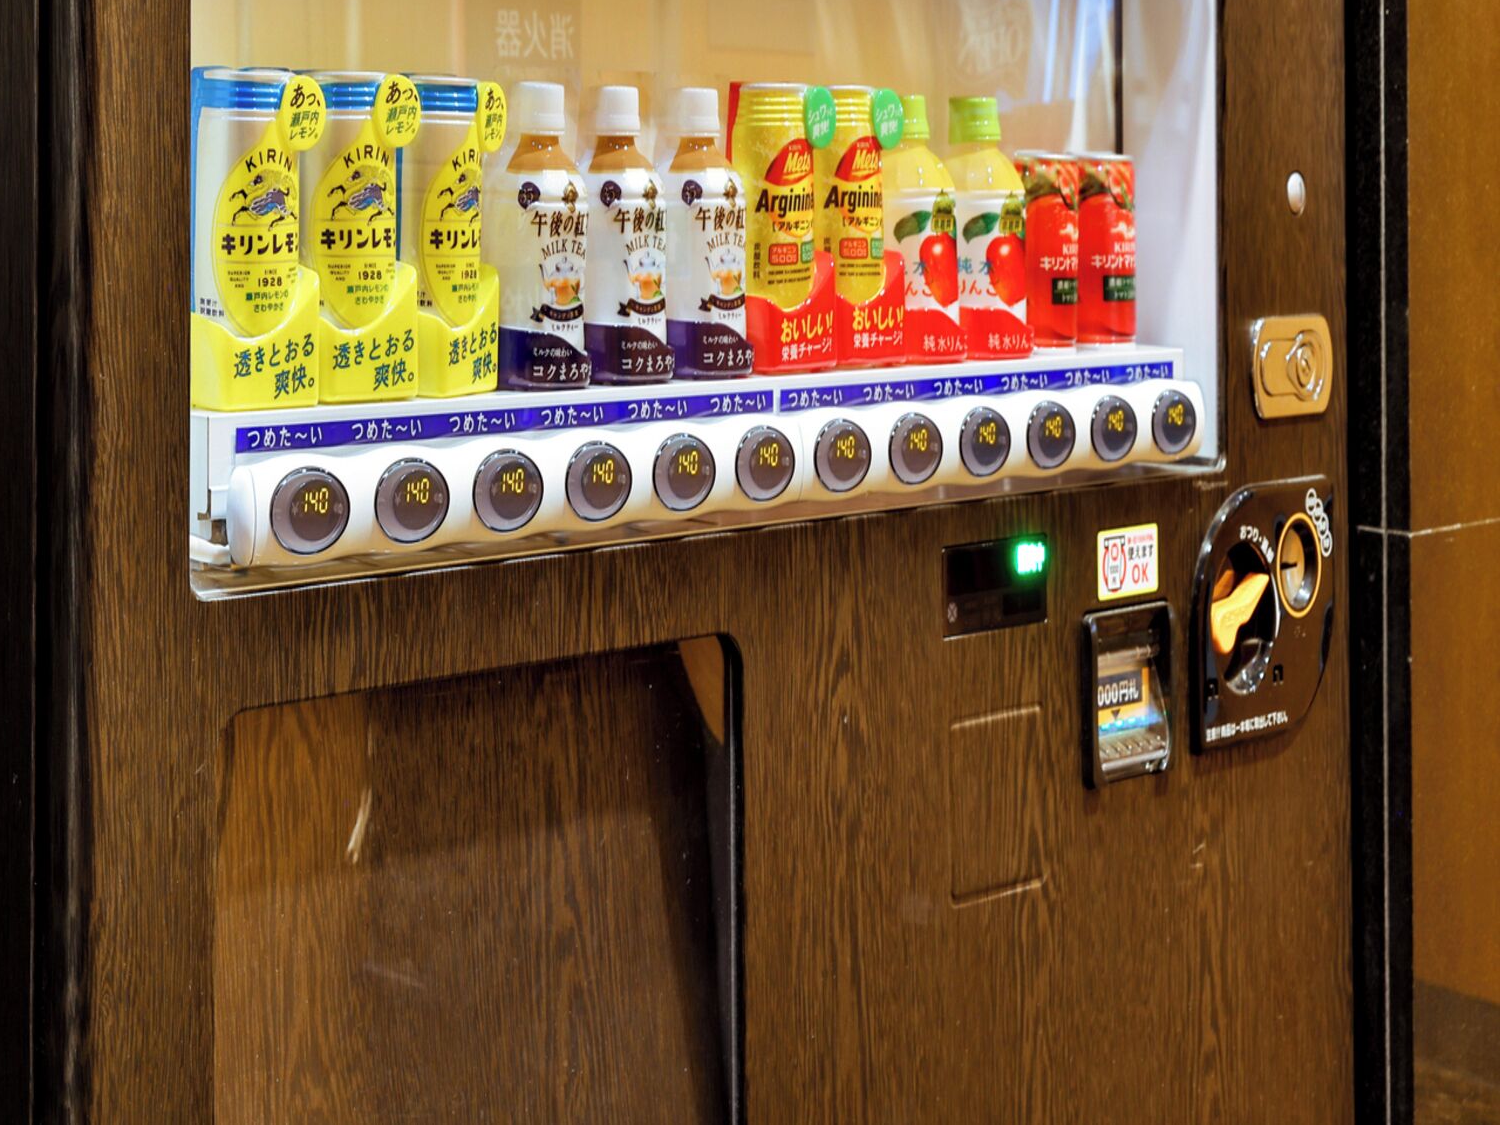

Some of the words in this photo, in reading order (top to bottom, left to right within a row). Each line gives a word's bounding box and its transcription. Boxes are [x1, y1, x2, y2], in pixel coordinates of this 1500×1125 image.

[290, 84, 321, 107] あっ、
[386, 81, 417, 104] あっ、
[485, 88, 504, 110] あっ、
[290, 108, 319, 126] 瀬戸内
[386, 106, 416, 124] 瀬戸内
[289, 125, 318, 141] レモン。
[386, 121, 416, 136] レモン。
[245, 148, 293, 173] KIRIN
[343, 144, 390, 169] KIRIN
[783, 150, 810, 173] Mets
[852, 149, 879, 172] Mets
[530, 210, 588, 238] 午後の紅
[613, 208, 667, 236] 午後の紅
[542, 238, 568, 260] MILK
[626, 235, 650, 252] MILK
[707, 234, 730, 252] MILK
[257, 276, 282, 288] 1928
[357, 270, 382, 281] 1928
[233, 333, 314, 378] 透きとおる
[333, 329, 414, 371] 透きとおる
[449, 322, 497, 366] 透きとおる
[373, 360, 414, 392] 爽快。
[472, 351, 497, 385] 爽快。
[274, 365, 314, 400] 爽快。
[759, 443, 780, 468] 140
[836, 435, 856, 459] 140
[592, 458, 616, 485] 140
[678, 450, 700, 476] 140
[405, 477, 432, 504] 140
[501, 468, 525, 495] 140
[302, 486, 330, 515] 140
[1132, 562, 1148, 585] OK
[1097, 678, 1139, 707] 000円札
